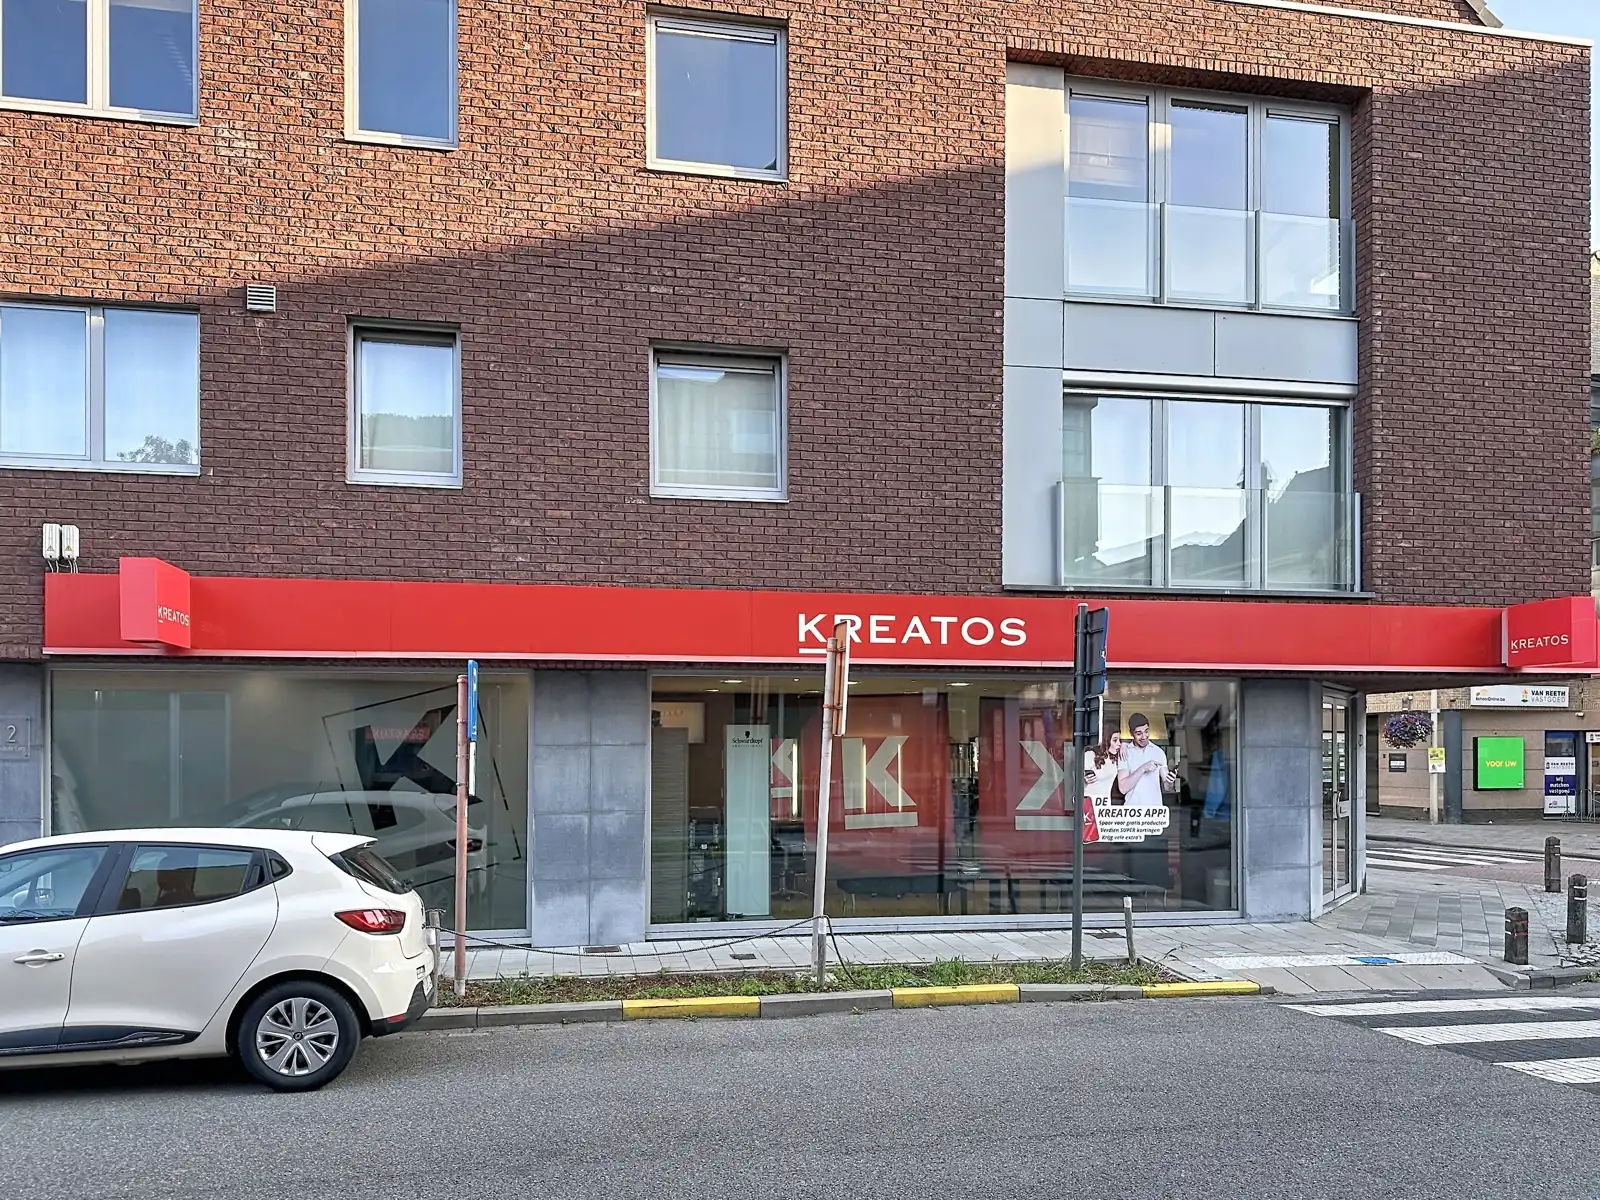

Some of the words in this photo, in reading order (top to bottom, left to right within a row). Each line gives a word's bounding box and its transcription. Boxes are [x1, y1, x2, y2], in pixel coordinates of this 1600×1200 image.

[157, 605, 190, 627] KREATOS
[798, 613, 1027, 647] KREATOS
[1511, 634, 1569, 650] KREATOS
[6, 725, 16, 743] 2
[842, 736, 916, 809] K
[1095, 797, 1108, 806] DE
[1098, 808, 1142, 818] KREATOS
[1144, 808, 1167, 818] APP!
